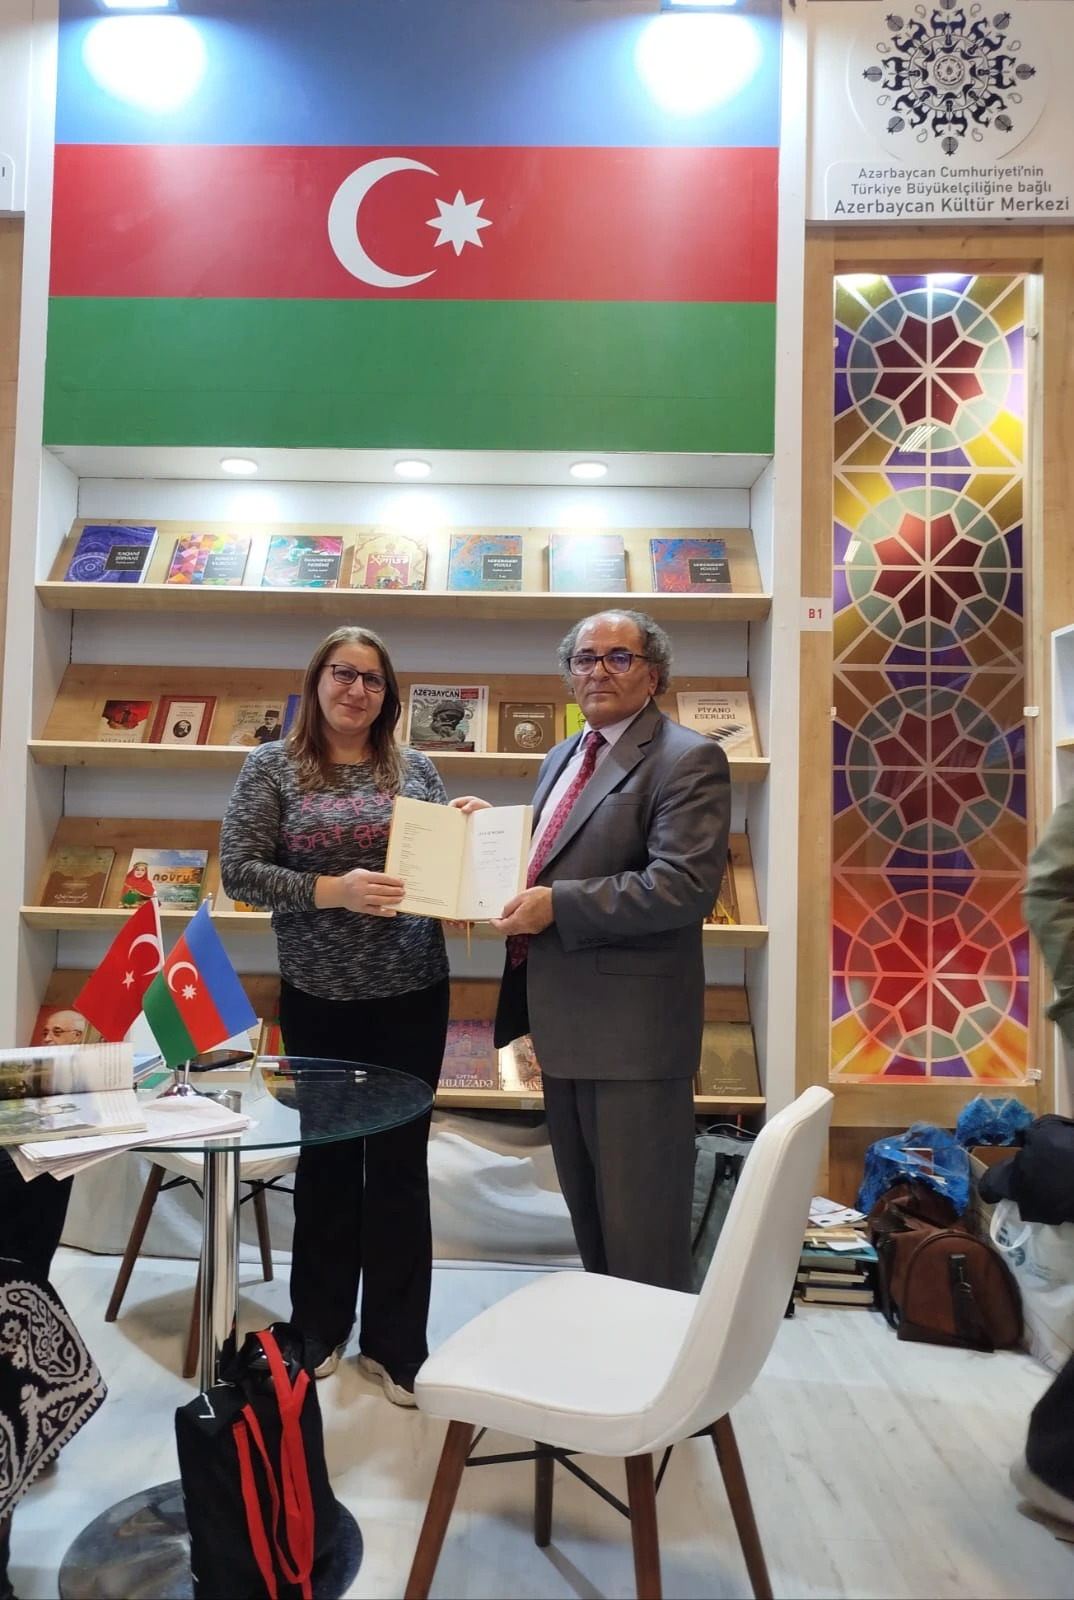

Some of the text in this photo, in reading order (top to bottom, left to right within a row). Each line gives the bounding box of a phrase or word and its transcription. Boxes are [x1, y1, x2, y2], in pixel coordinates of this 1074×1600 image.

[858, 167, 936, 181] Azərbaycan
[851, 180, 1052, 197] Türkiye Büyükelçiliğine bağlı
[834, 196, 1069, 217] Azerbaycan Kültür Merkezi
[808, 608, 822, 619] B1
